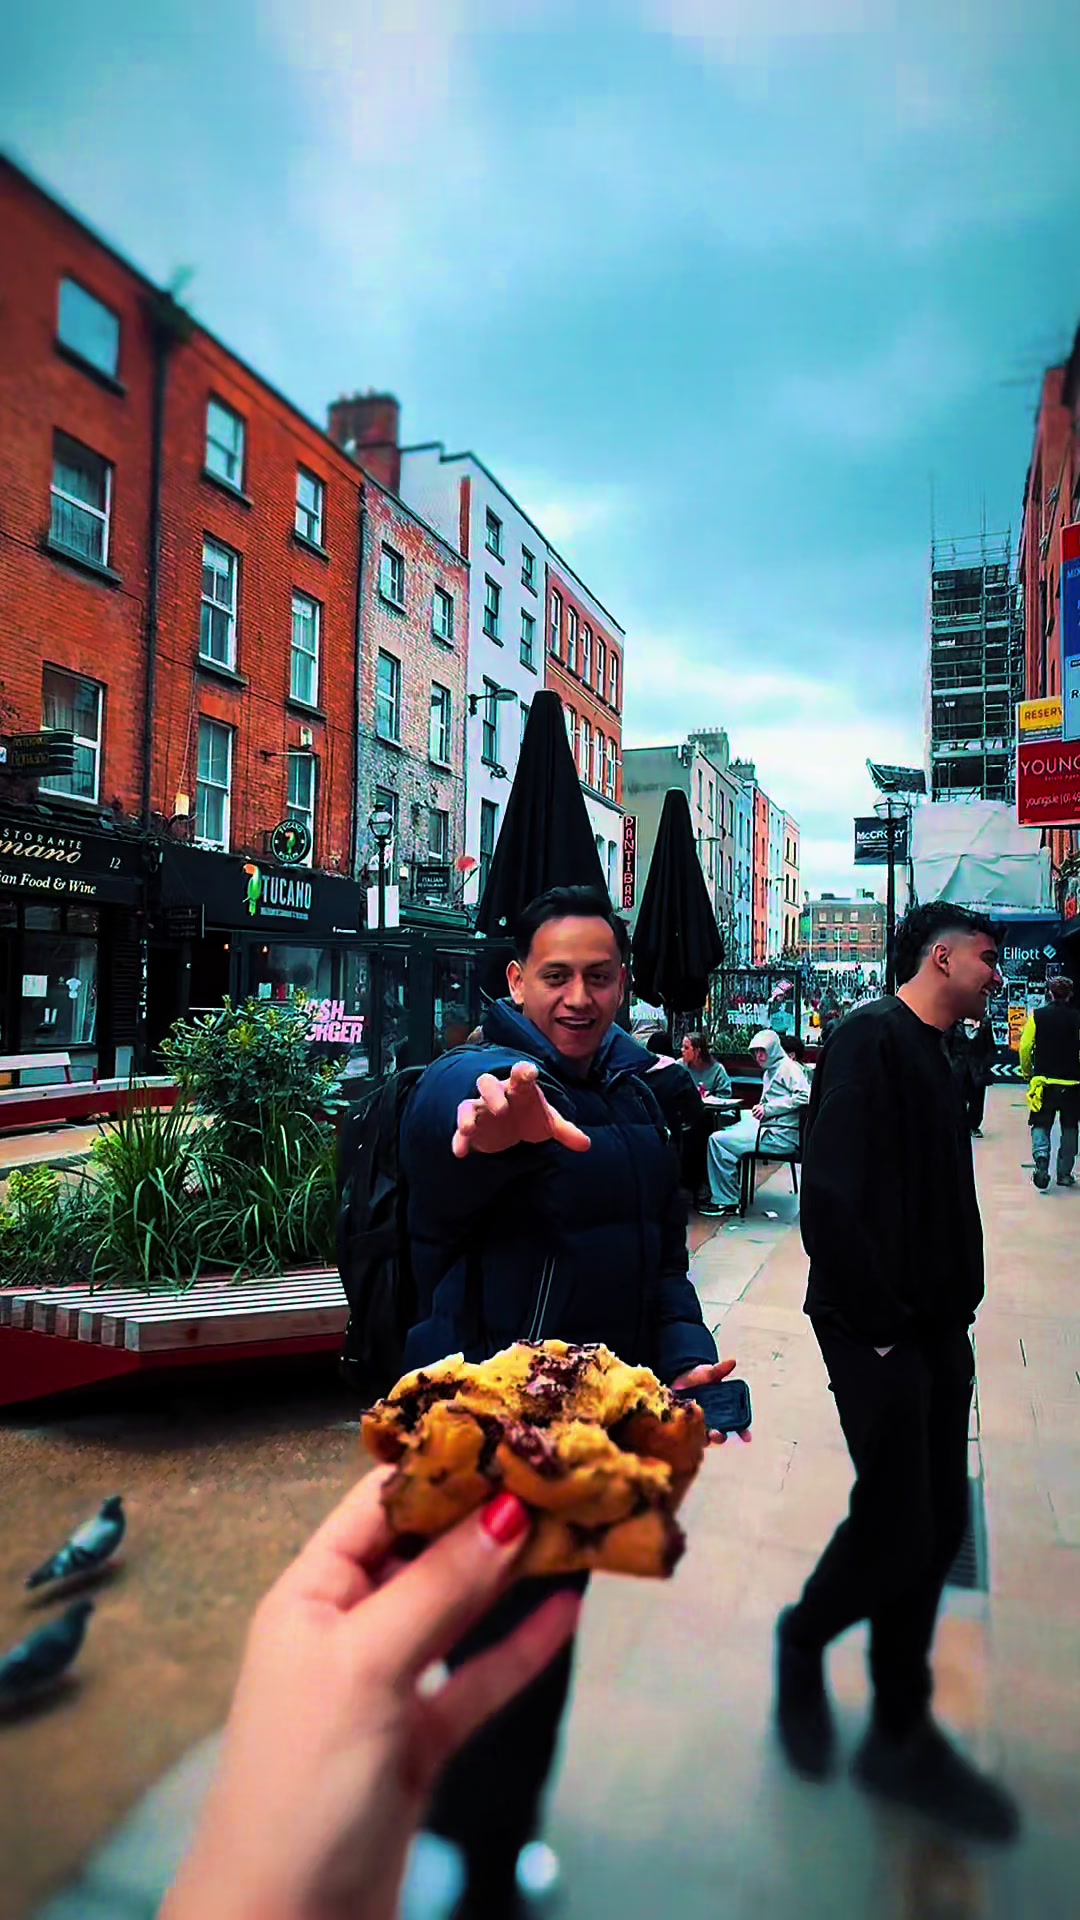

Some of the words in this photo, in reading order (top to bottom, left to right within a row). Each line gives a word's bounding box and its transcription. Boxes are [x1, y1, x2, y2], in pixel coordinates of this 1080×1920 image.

[3, 828, 82, 850] STORANTE
[109, 857, 121, 869] 12
[624, 816, 635, 906] PANTIBAR
[20, 873, 51, 888] Food
[53, 877, 66, 890] &
[69, 879, 97, 895] Wine
[261, 875, 312, 909] TUCANO
[1003, 947, 1041, 960] Elliott
